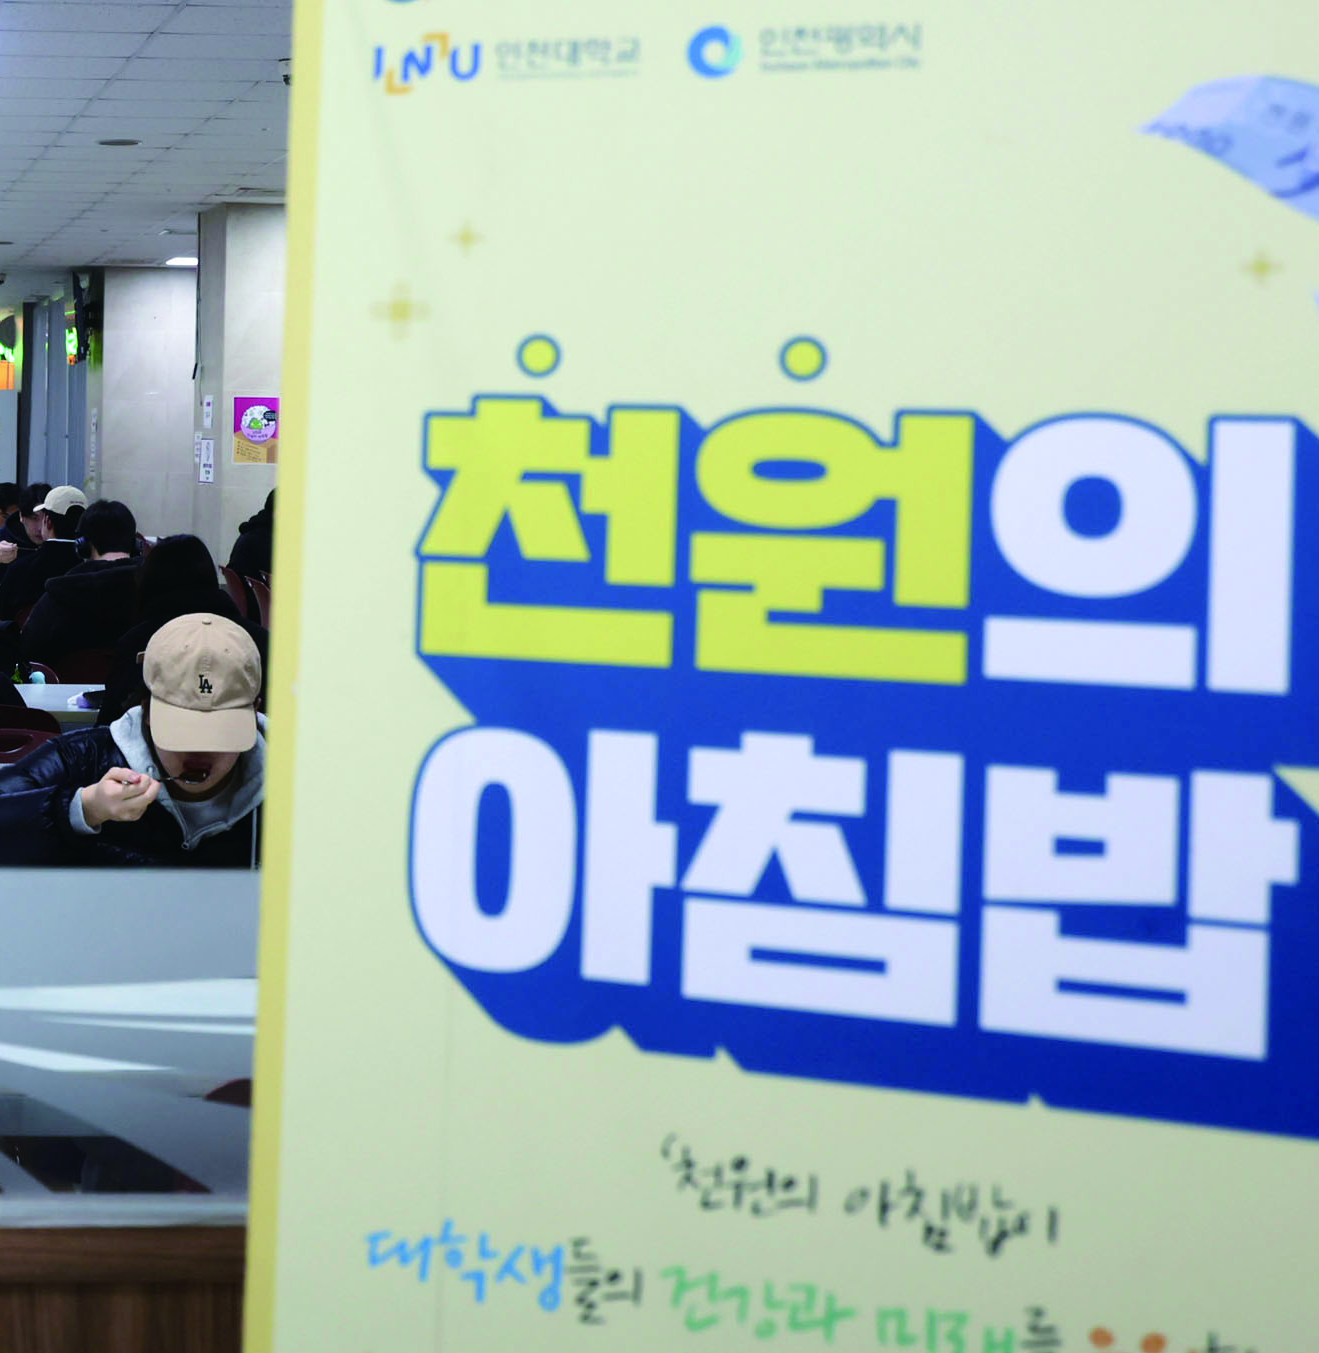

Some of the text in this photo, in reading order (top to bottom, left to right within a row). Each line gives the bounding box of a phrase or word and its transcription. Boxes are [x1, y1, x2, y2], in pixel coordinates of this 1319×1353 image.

[417, 395, 1298, 694] 천원의
[198, 674, 213, 694] LA
[410, 725, 1300, 1060] 아침밥
[365, 1218, 644, 1326] 대학생들의
[659, 1264, 857, 1345] 건강과
